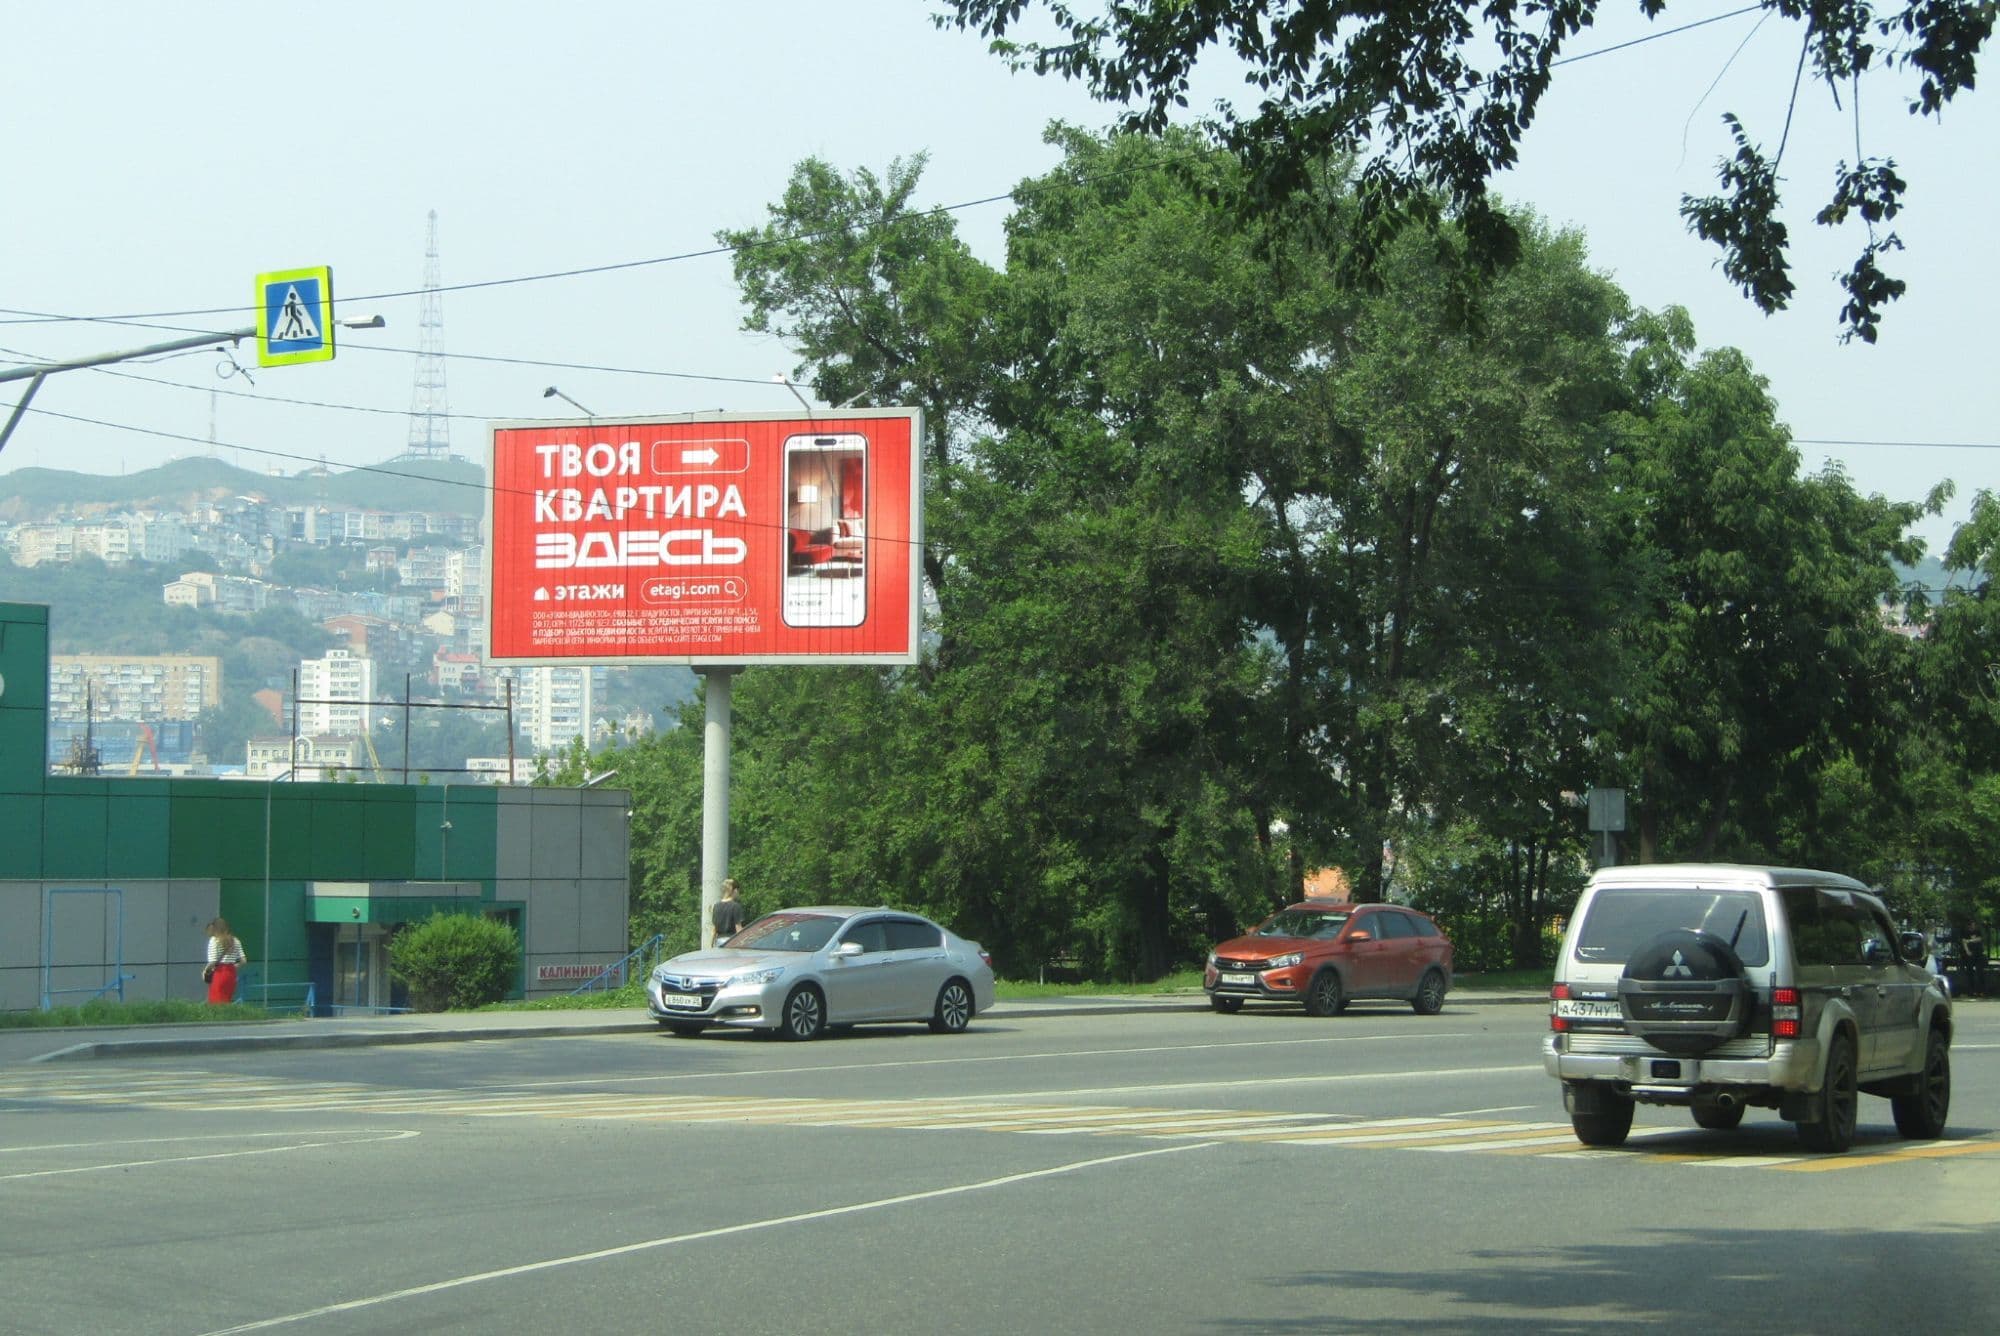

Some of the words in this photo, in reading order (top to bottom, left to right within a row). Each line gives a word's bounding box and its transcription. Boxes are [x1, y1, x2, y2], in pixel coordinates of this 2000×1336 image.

[536, 441, 641, 477] ТВОЯ
[535, 484, 747, 522] КВАРТИРА
[535, 529, 747, 569] ЗДЕСЬ
[554, 584, 624, 600] этажи
[650, 582, 720, 599] etagi.com
